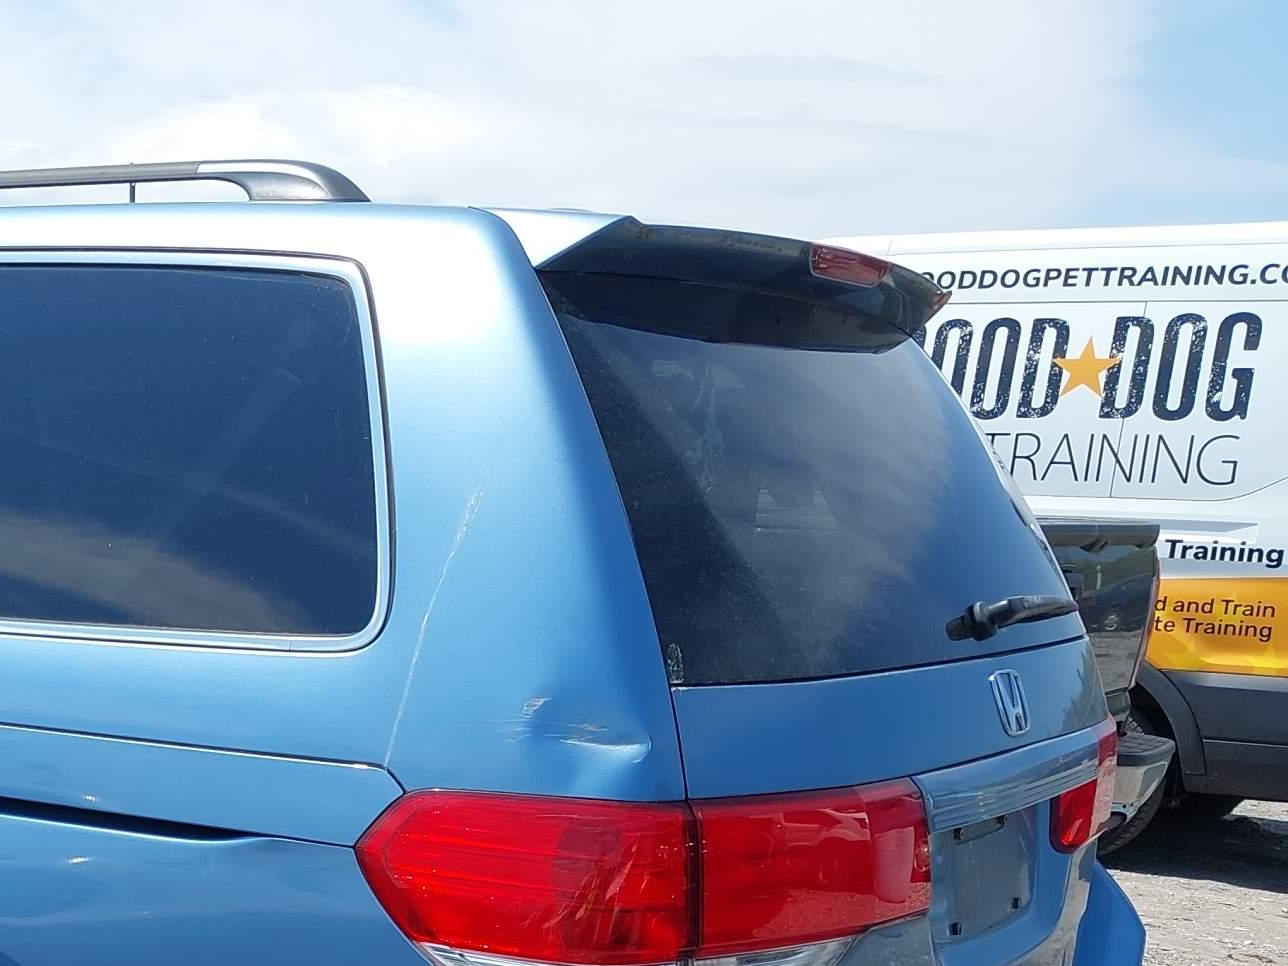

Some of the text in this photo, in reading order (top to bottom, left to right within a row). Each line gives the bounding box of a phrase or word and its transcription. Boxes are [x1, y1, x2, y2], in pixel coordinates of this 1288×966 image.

[913, 312, 1263, 421] OOD DOG
[1165, 539, 1285, 569] Training
[1173, 599, 1215, 615] and
[1221, 599, 1276, 618] Train
[1183, 617, 1273, 643] Training
